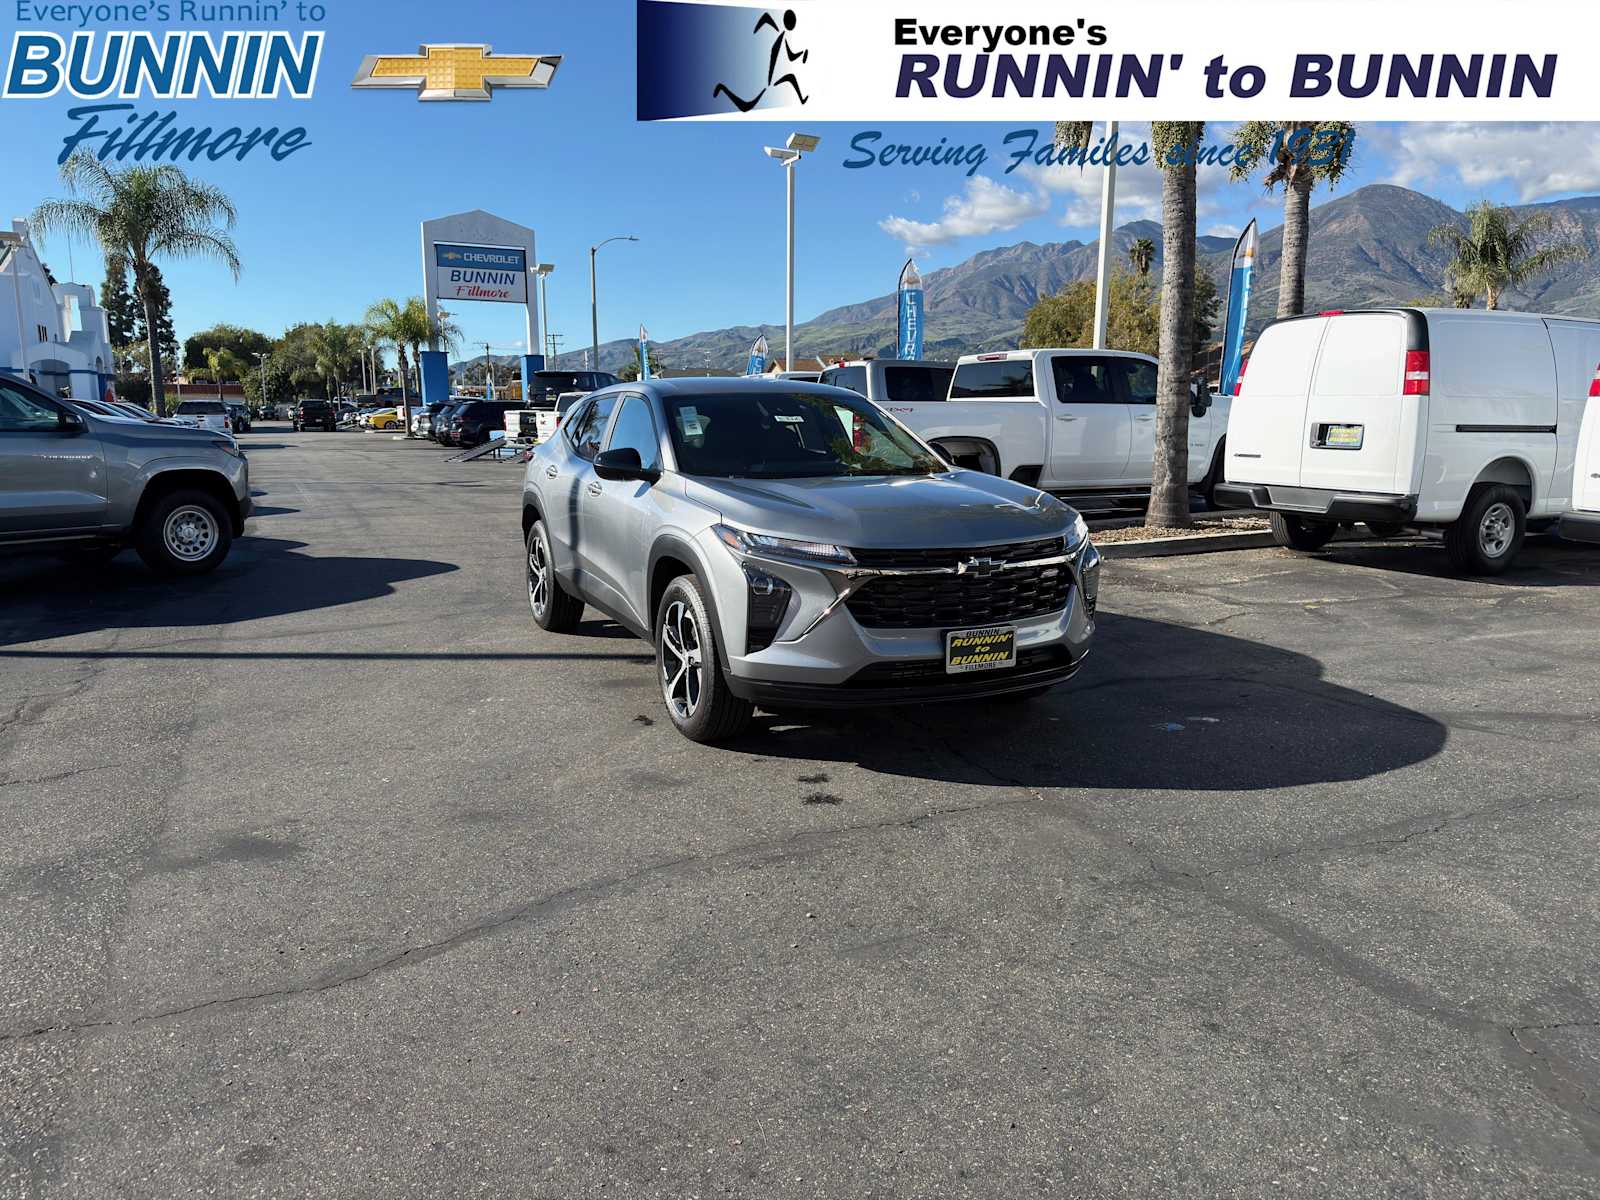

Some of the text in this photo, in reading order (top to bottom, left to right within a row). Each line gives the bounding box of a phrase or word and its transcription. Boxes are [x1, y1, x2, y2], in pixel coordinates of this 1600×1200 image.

[463, 252, 520, 264] CHEVROLET
[450, 269, 516, 285] BUNNIN
[454, 285, 511, 298] Fillmore
[951, 633, 1013, 648] RUNNIN'
[974, 645, 991, 653] to
[950, 651, 1009, 665] BUNNIN
